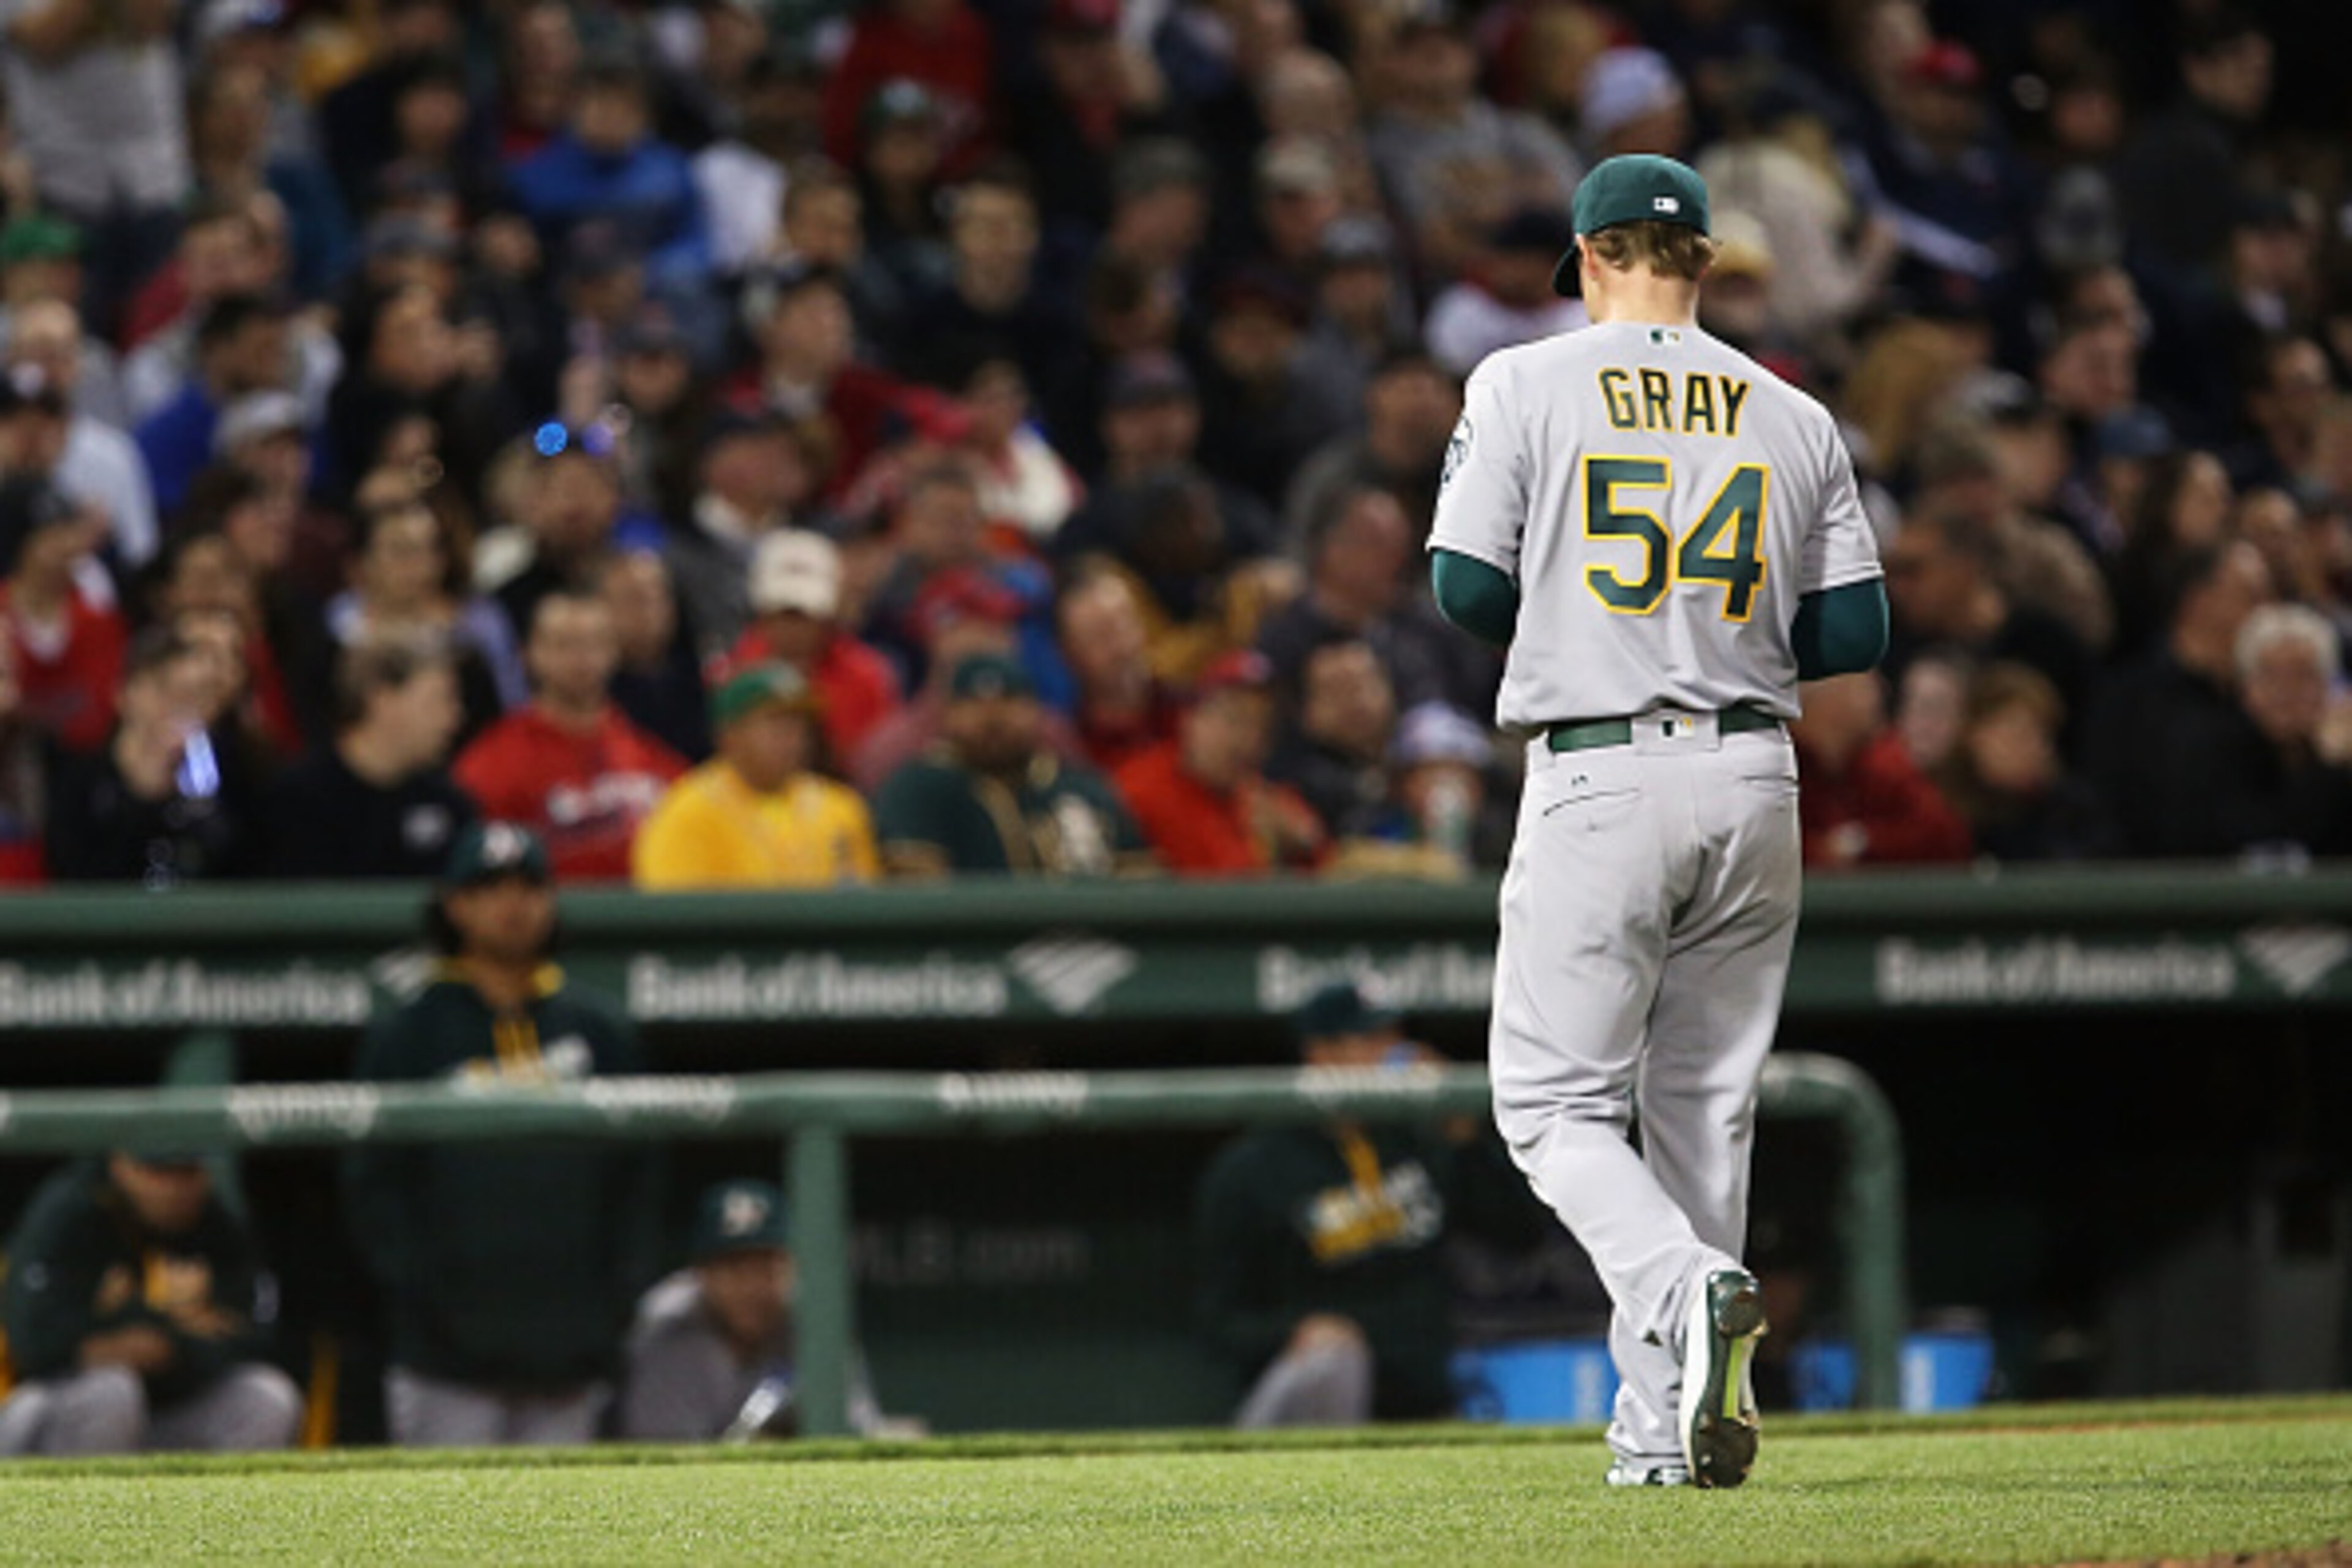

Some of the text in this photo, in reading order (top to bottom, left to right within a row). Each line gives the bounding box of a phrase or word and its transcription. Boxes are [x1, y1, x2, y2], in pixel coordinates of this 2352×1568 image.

[1596, 368, 1750, 437] GRAY
[1581, 453, 1770, 622] 54
[174, 959, 371, 1023] America
[631, 952, 1006, 1020] Bank of America
[1878, 935, 2236, 1005] Bank of America
